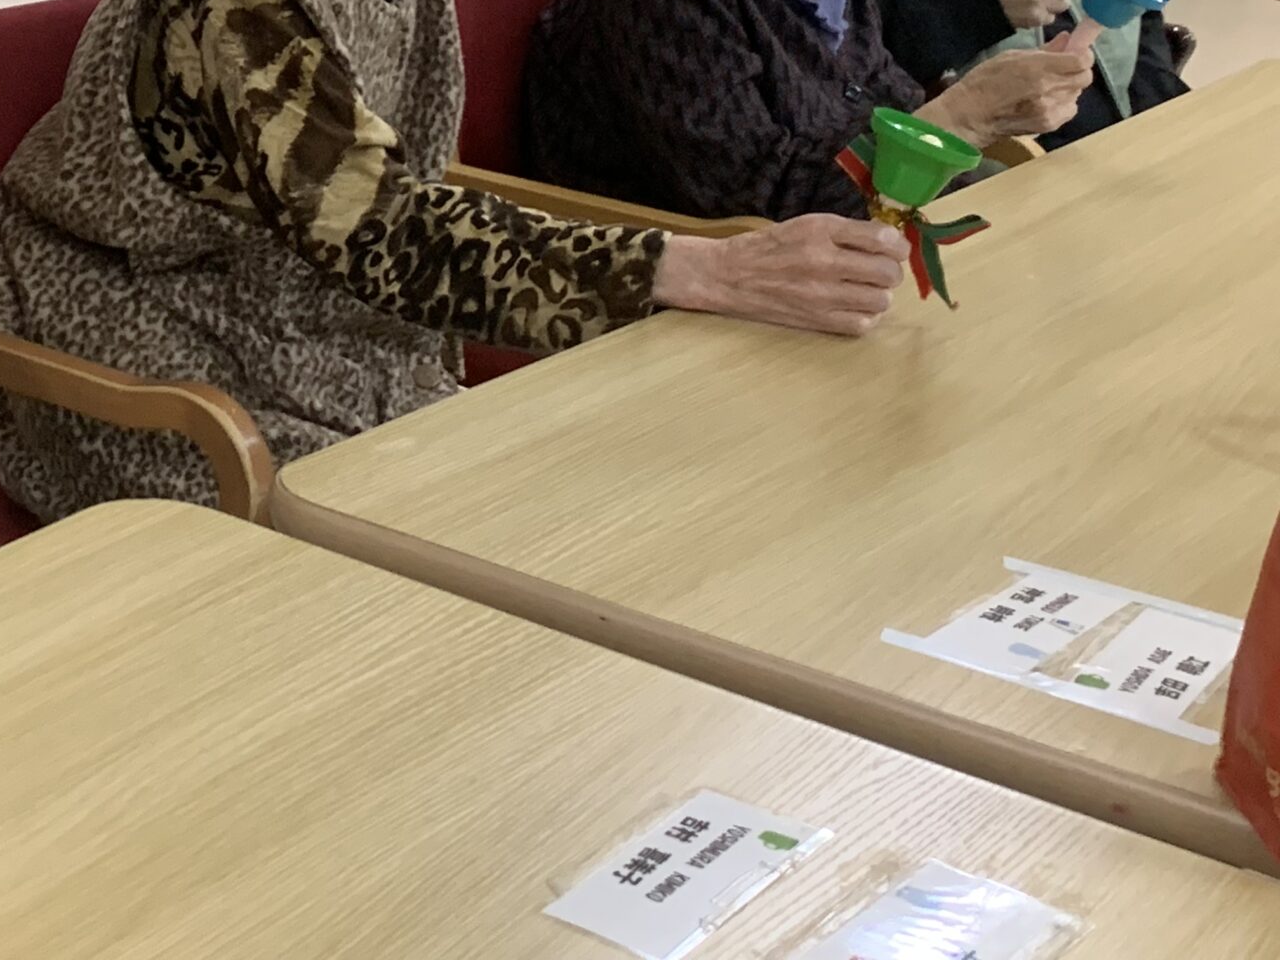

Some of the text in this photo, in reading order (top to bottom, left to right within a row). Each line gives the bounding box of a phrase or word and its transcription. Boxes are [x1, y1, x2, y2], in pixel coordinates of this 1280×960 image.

[1154, 677, 1189, 700] 吉田
[613, 816, 711, 885] 吉村 喜美子
[645, 824, 752, 903] YOSHIMURA KIMIKO
